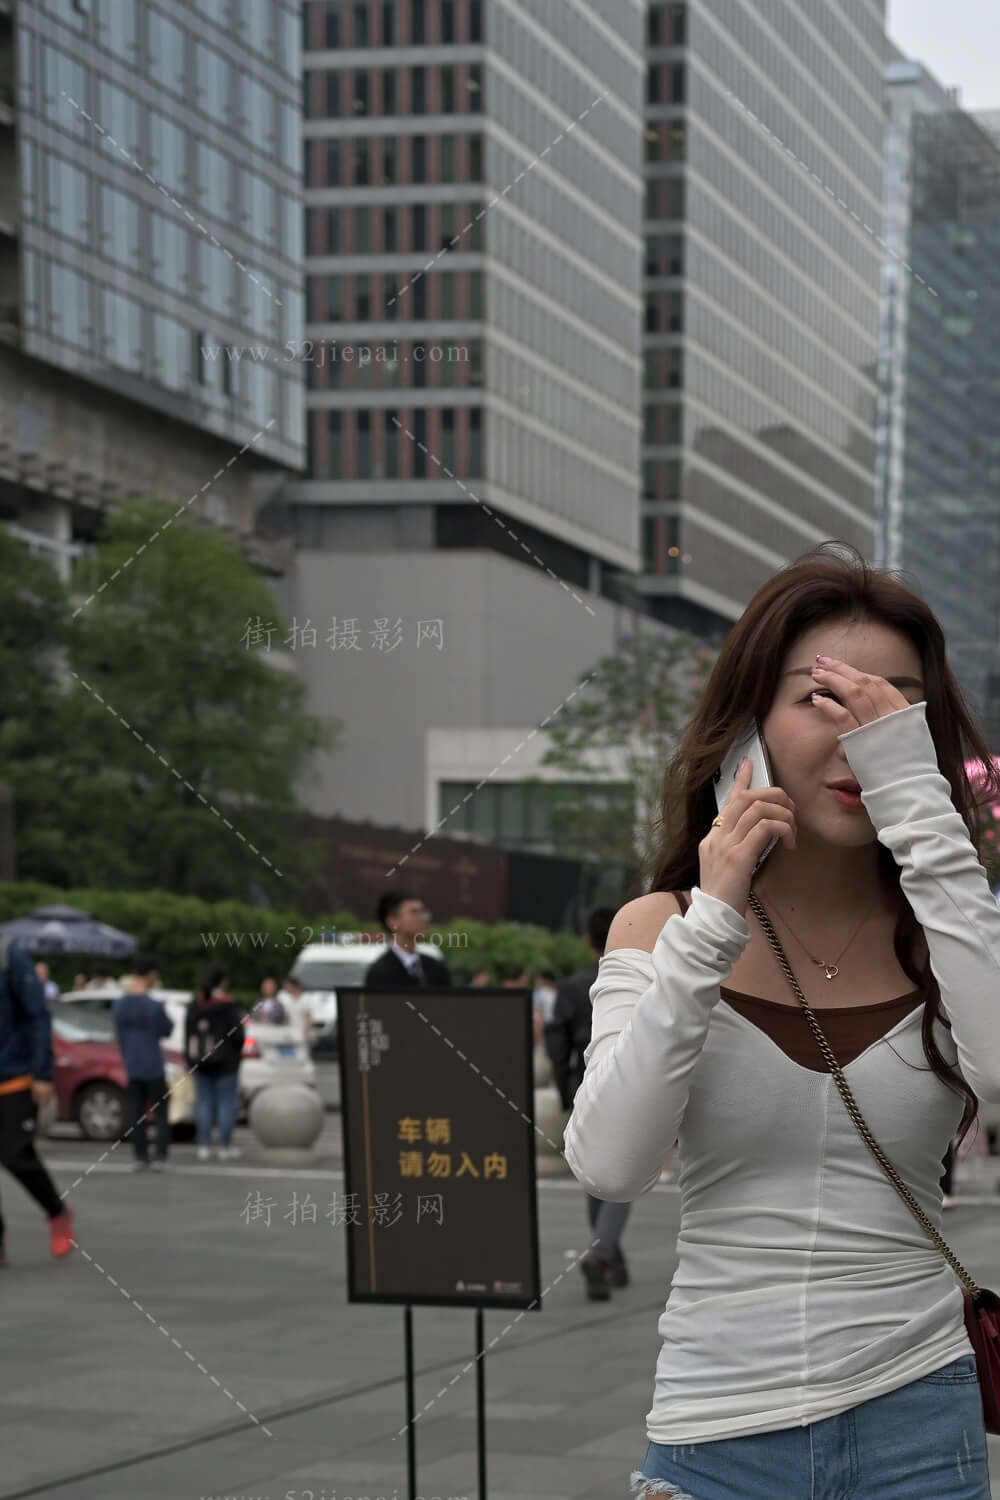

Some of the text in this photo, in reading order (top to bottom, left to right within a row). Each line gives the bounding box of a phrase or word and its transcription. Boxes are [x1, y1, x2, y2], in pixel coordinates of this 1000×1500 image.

[397, 1117, 451, 1144] 车辆
[398, 1150, 508, 1180] 请勿入内
